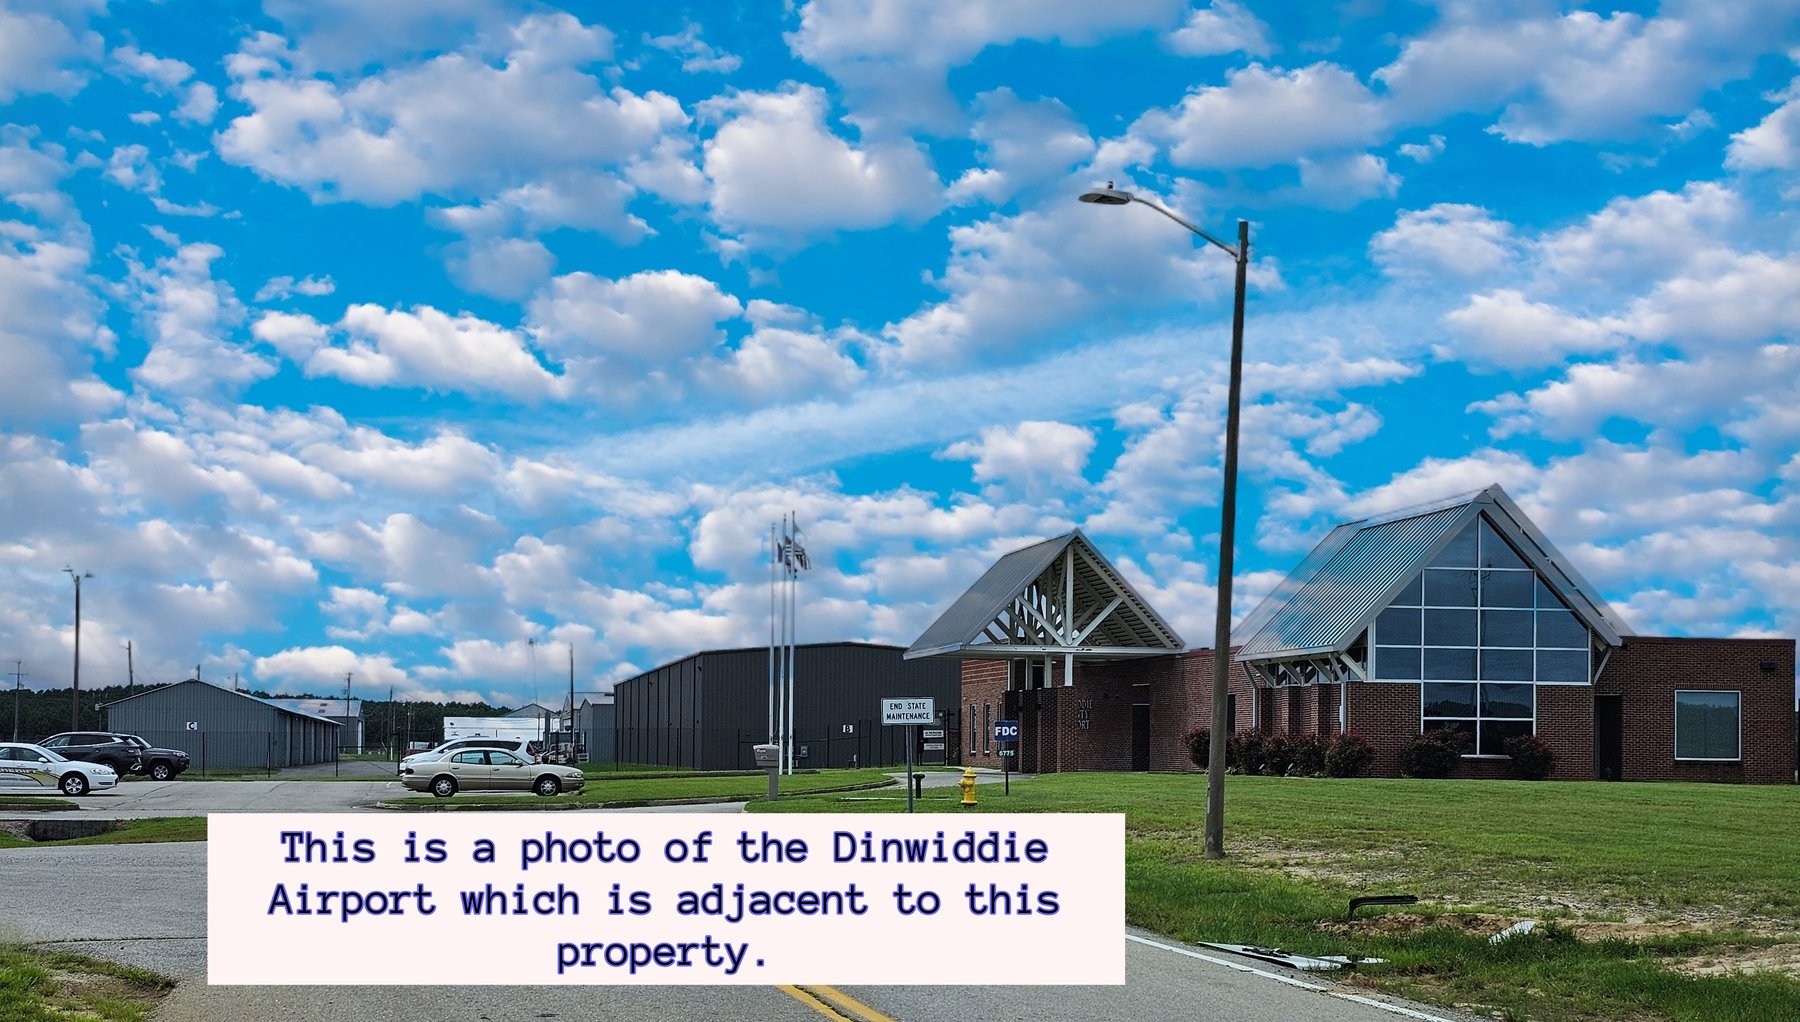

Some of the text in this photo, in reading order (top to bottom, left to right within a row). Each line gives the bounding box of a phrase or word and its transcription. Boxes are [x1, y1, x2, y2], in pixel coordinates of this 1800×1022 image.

[889, 702, 927, 710] END STATE
[886, 712, 931, 720] MAINTENANCE
[994, 726, 1018, 736] FDC
